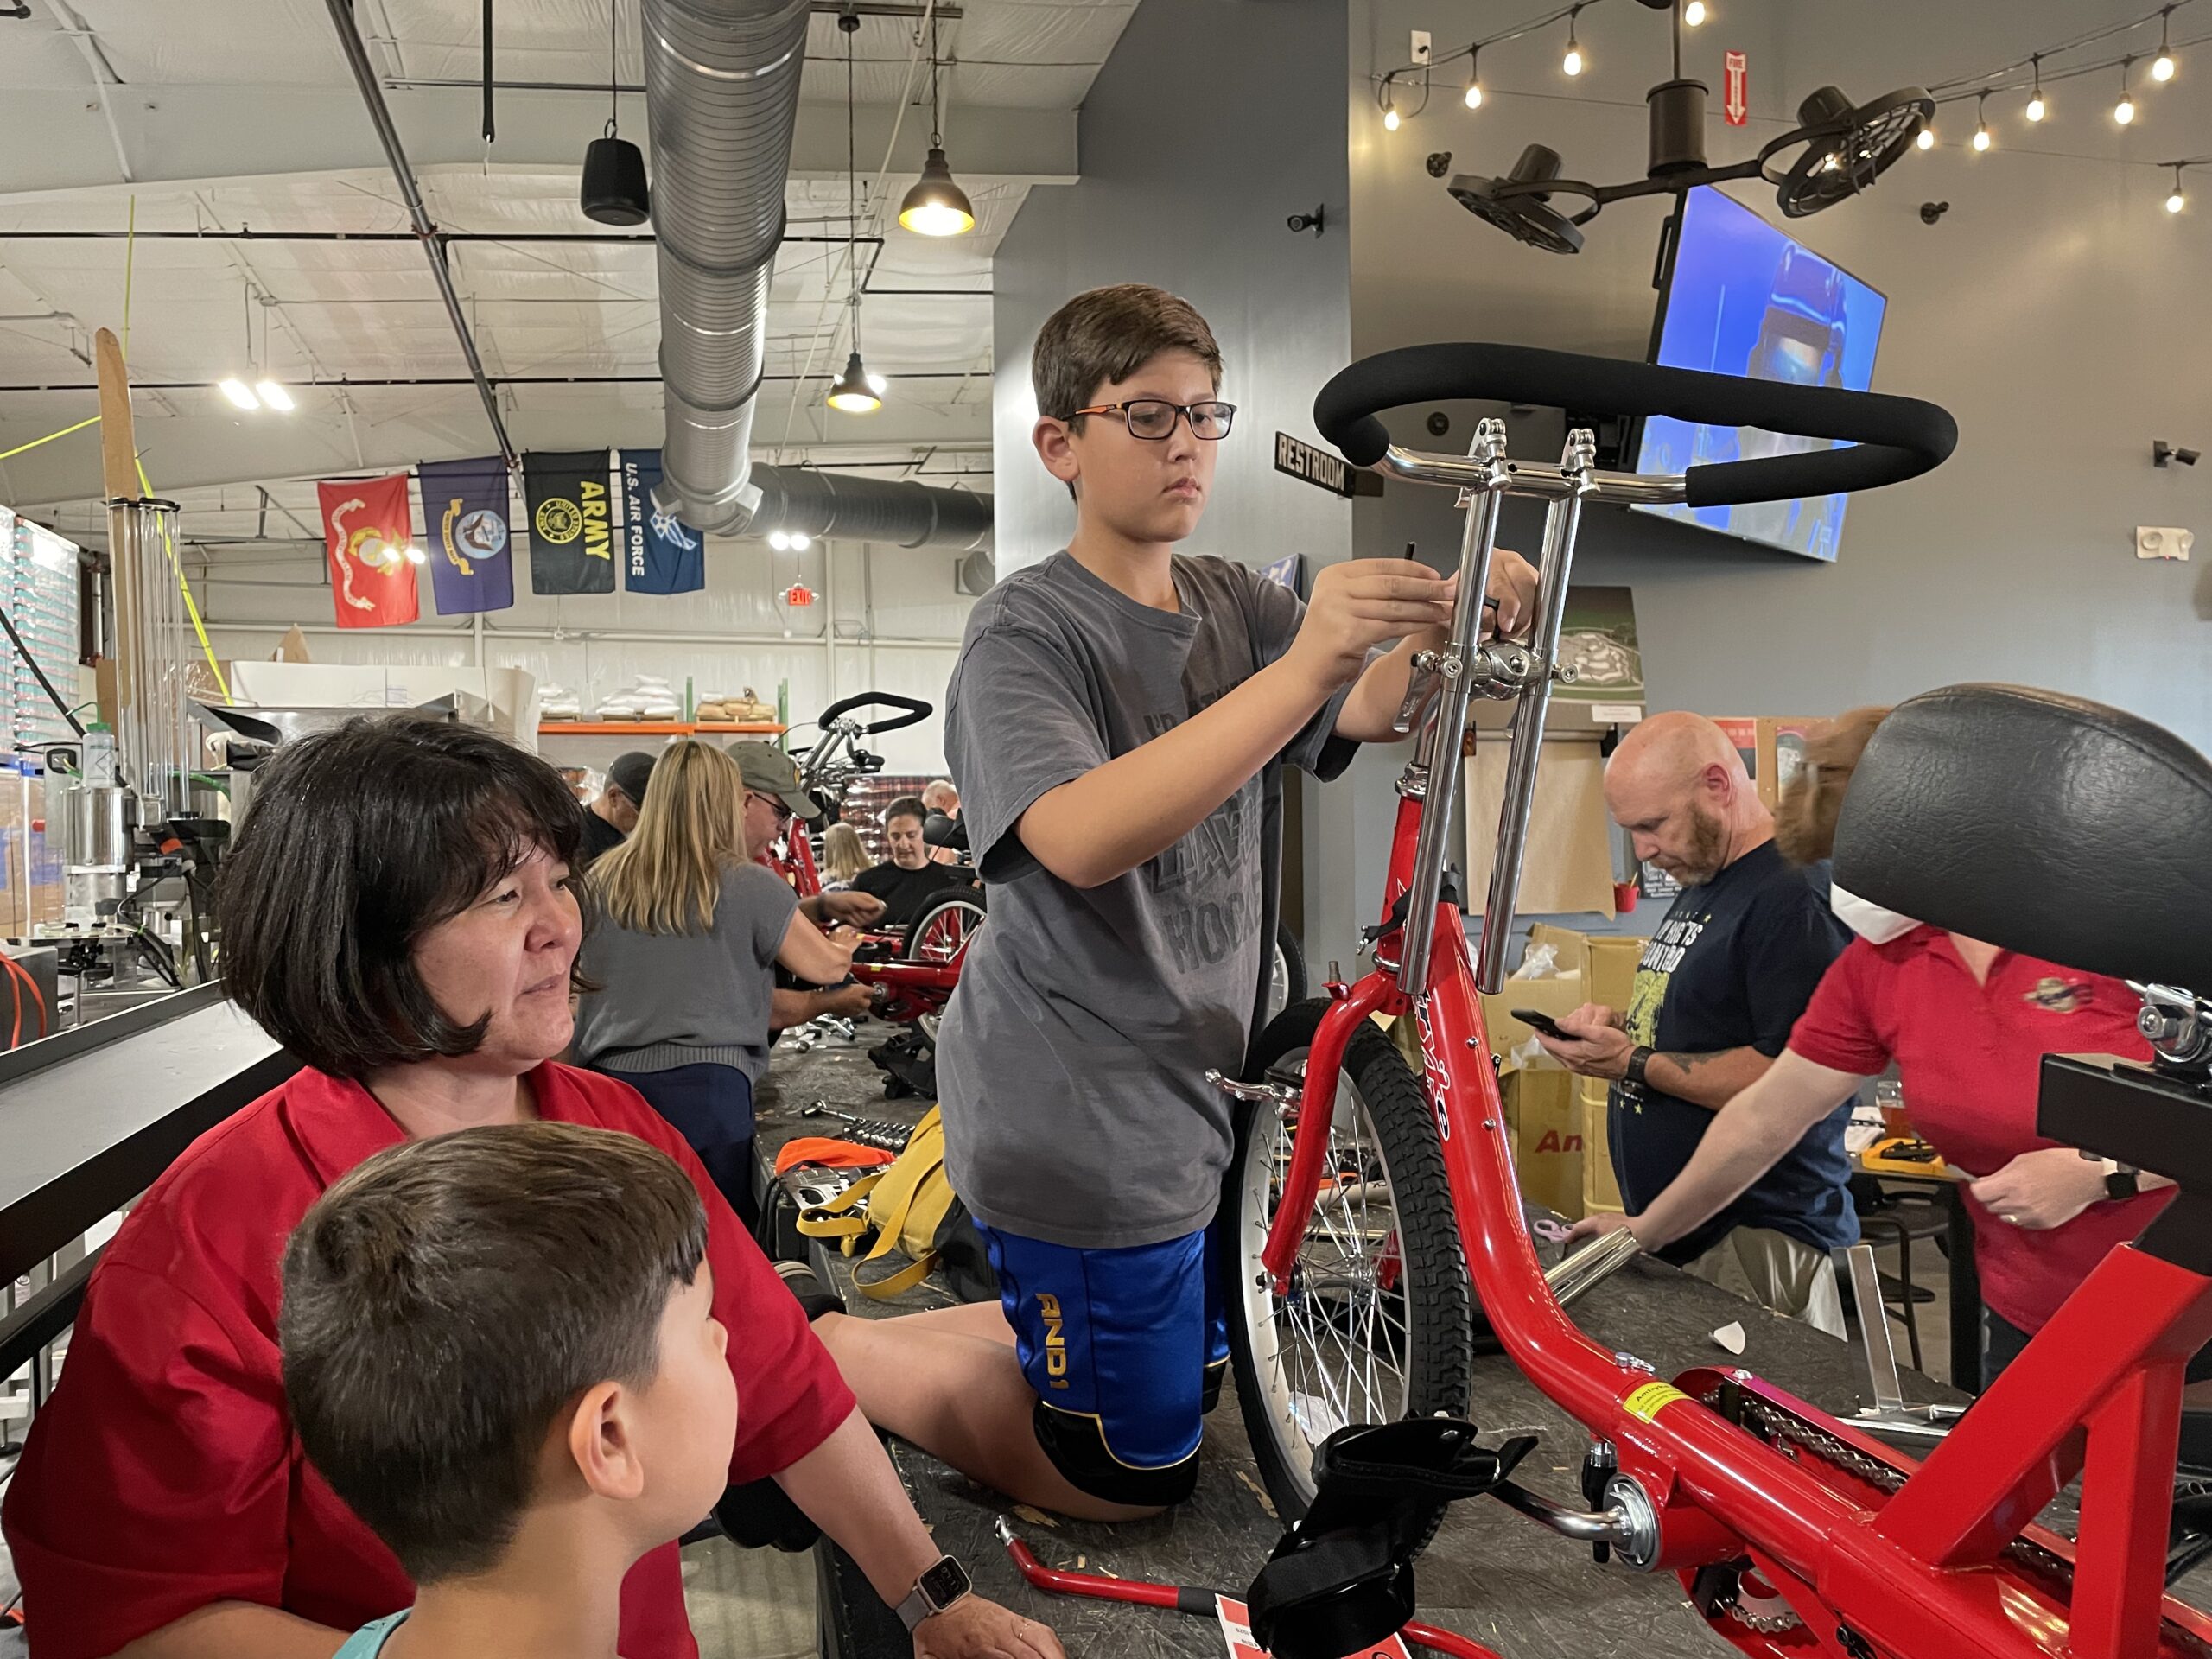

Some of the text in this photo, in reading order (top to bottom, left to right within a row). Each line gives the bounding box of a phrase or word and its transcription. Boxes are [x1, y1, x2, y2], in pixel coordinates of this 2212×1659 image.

[1729, 58, 1743, 69] FIRE
[1278, 434, 1345, 492] RESTROOM
[580, 480, 611, 561] ARMY
[626, 462, 645, 576] U.S. AIR FORCE
[790, 589, 810, 604] EXIT
